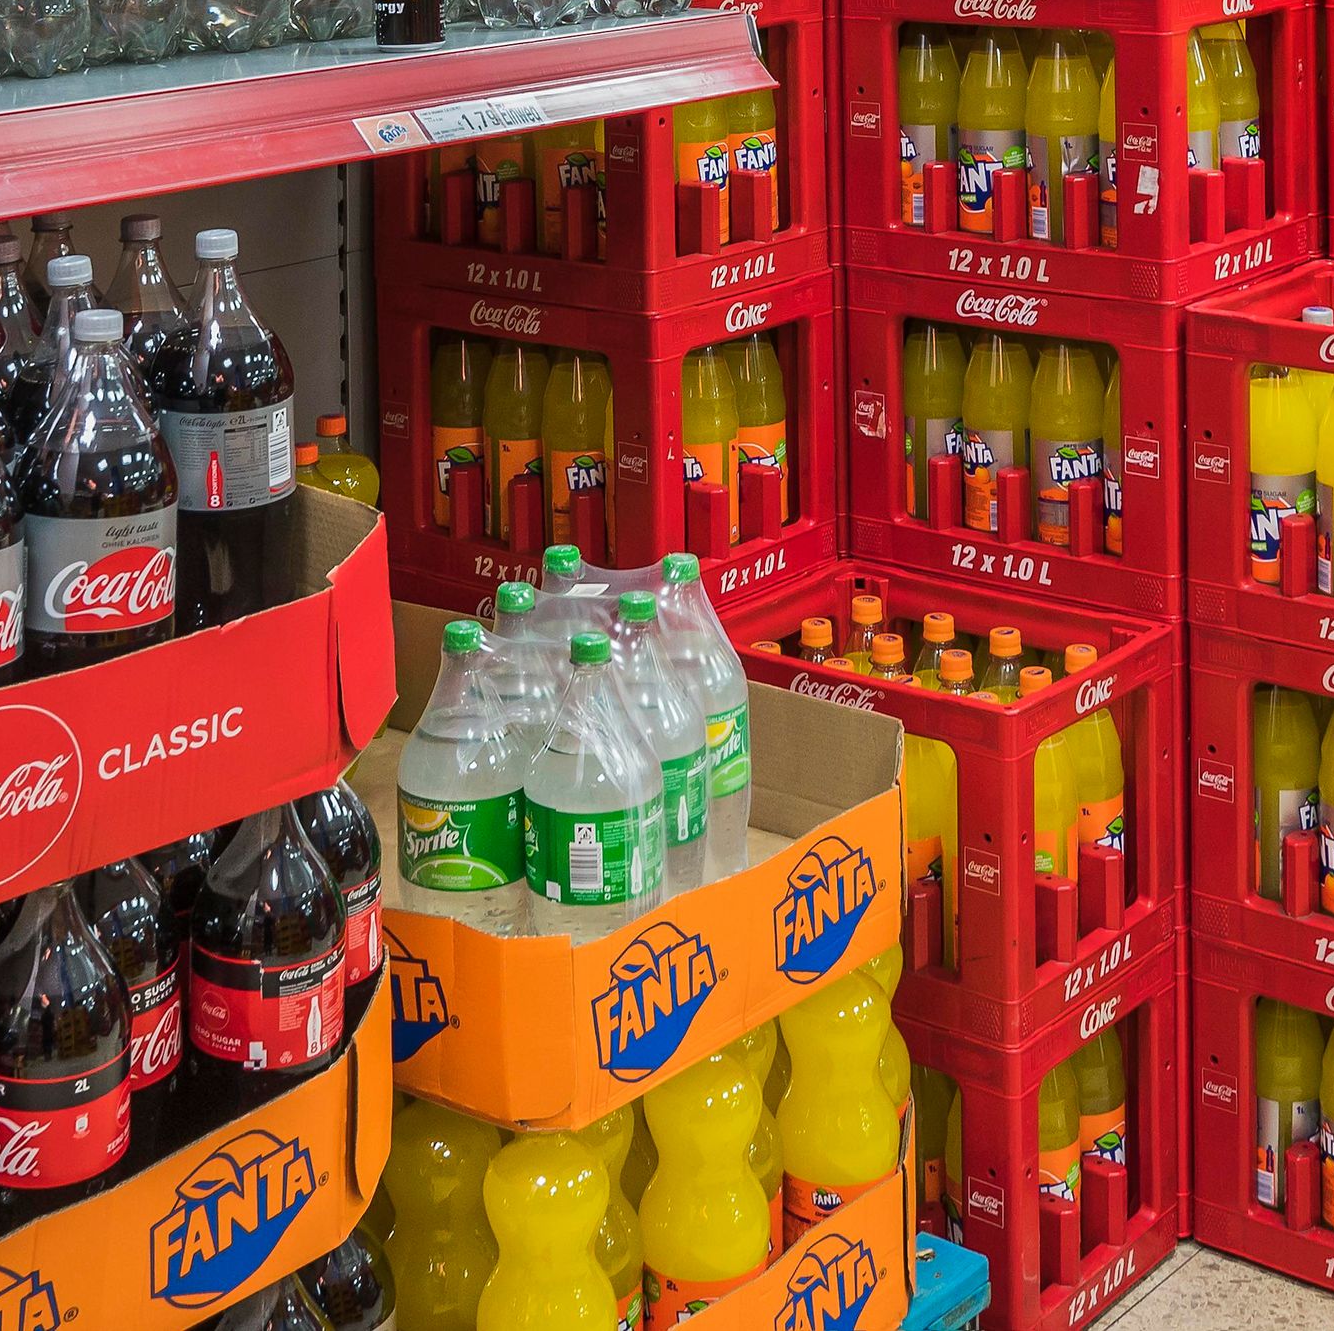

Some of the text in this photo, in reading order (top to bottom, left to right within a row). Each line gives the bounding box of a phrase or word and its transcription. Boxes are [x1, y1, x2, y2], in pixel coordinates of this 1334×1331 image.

[957, 289, 1041, 326] Coca-Cola
[98, 707, 243, 781] CLASSIC
[404, 827, 461, 856] Sprite
[778, 861, 875, 956] FANTA
[596, 943, 715, 1051] FANTA
[151, 1149, 315, 1297] FANTA
